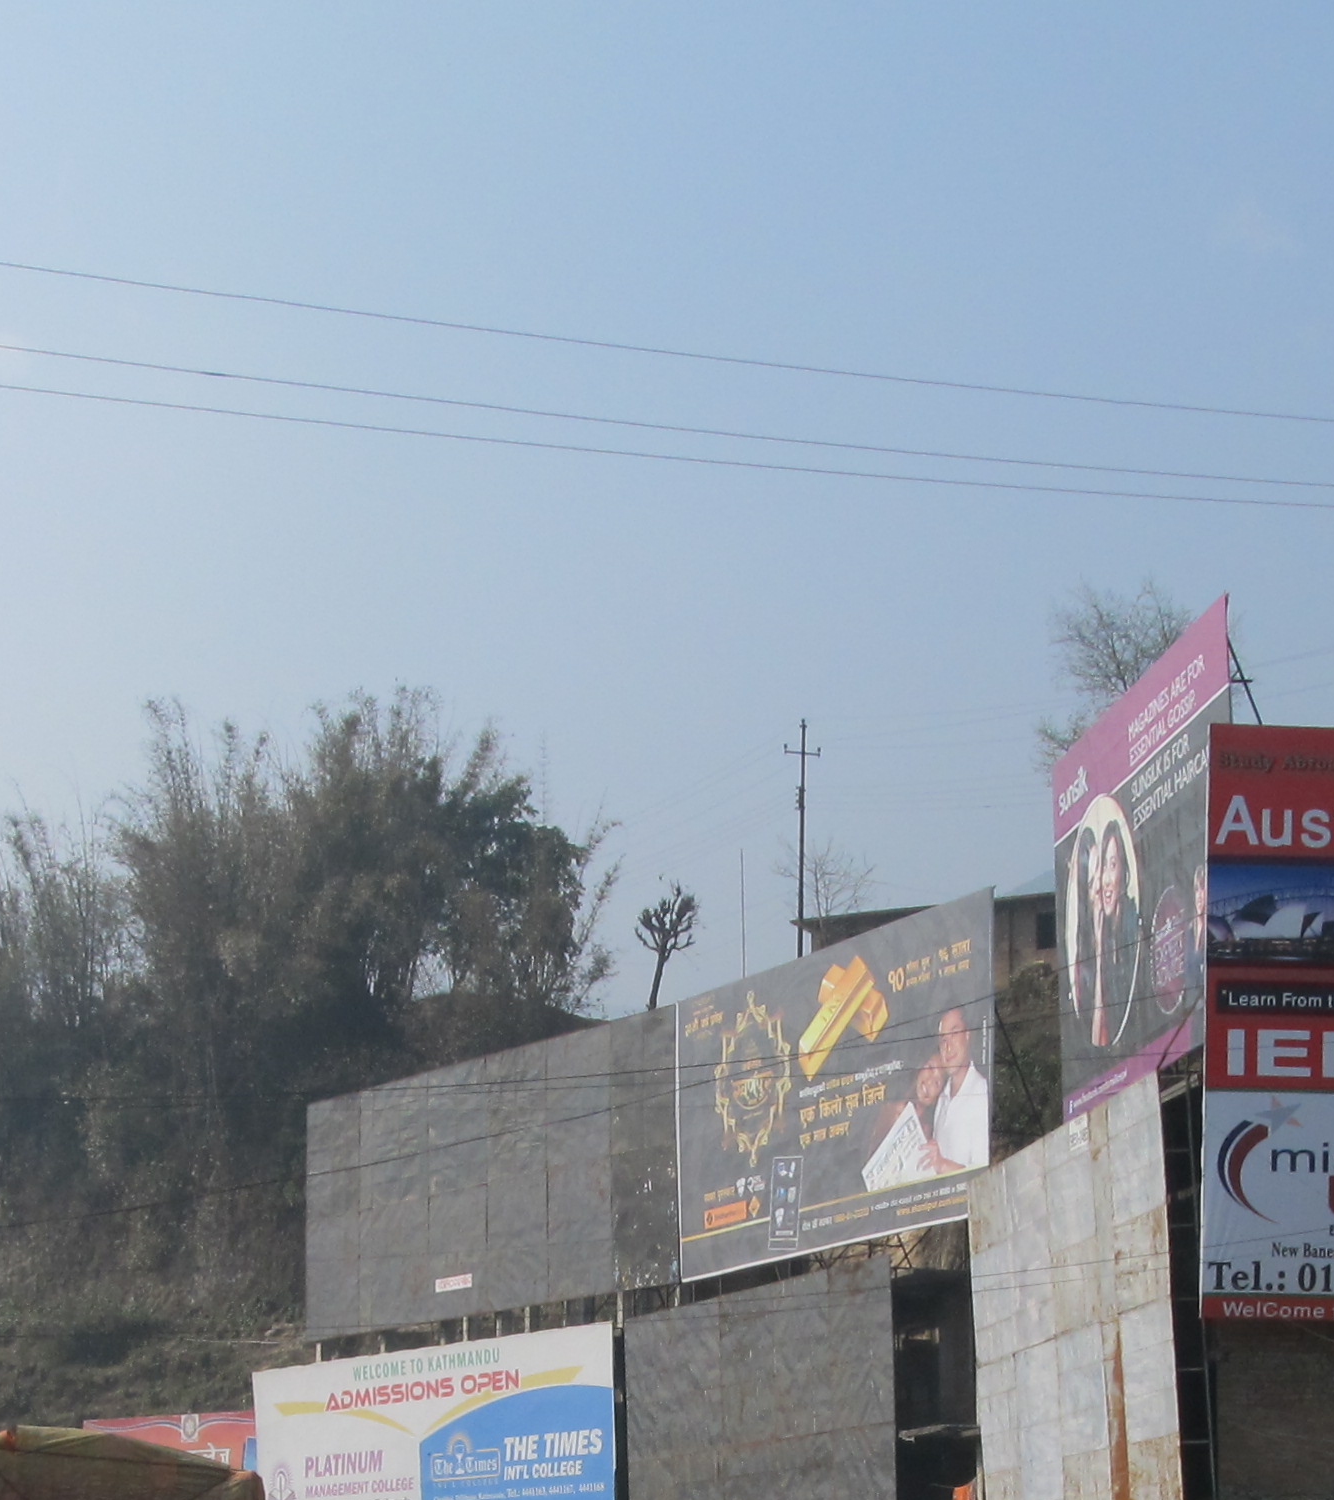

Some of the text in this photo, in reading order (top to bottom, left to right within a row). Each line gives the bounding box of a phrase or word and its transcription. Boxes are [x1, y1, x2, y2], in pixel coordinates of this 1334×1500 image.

[1128, 654, 1206, 742] MAGAZINES ARE FOR
[1130, 720, 1167, 767] ESSENTIAL
[1131, 756, 1163, 803] SUNSILK
[1172, 733, 1191, 764] FOR
[1133, 778, 1175, 832] ESSENTIAL
[1282, 993, 1322, 1008] From
[1271, 1242, 1298, 1257] New
[1208, 1261, 1286, 1292] Tel.:
[353, 1348, 499, 1381] WELCOME TO KATHMANDU
[324, 1369, 519, 1411] ADMISSIONS OPEN
[504, 1429, 603, 1461] THE TIMES
[305, 1450, 383, 1478] PLATINUM
[434, 1455, 498, 1475] The Times
[504, 1460, 583, 1480] INT'L COLLEGE
[306, 1477, 414, 1498] MANAGEMENT COLLEGE
